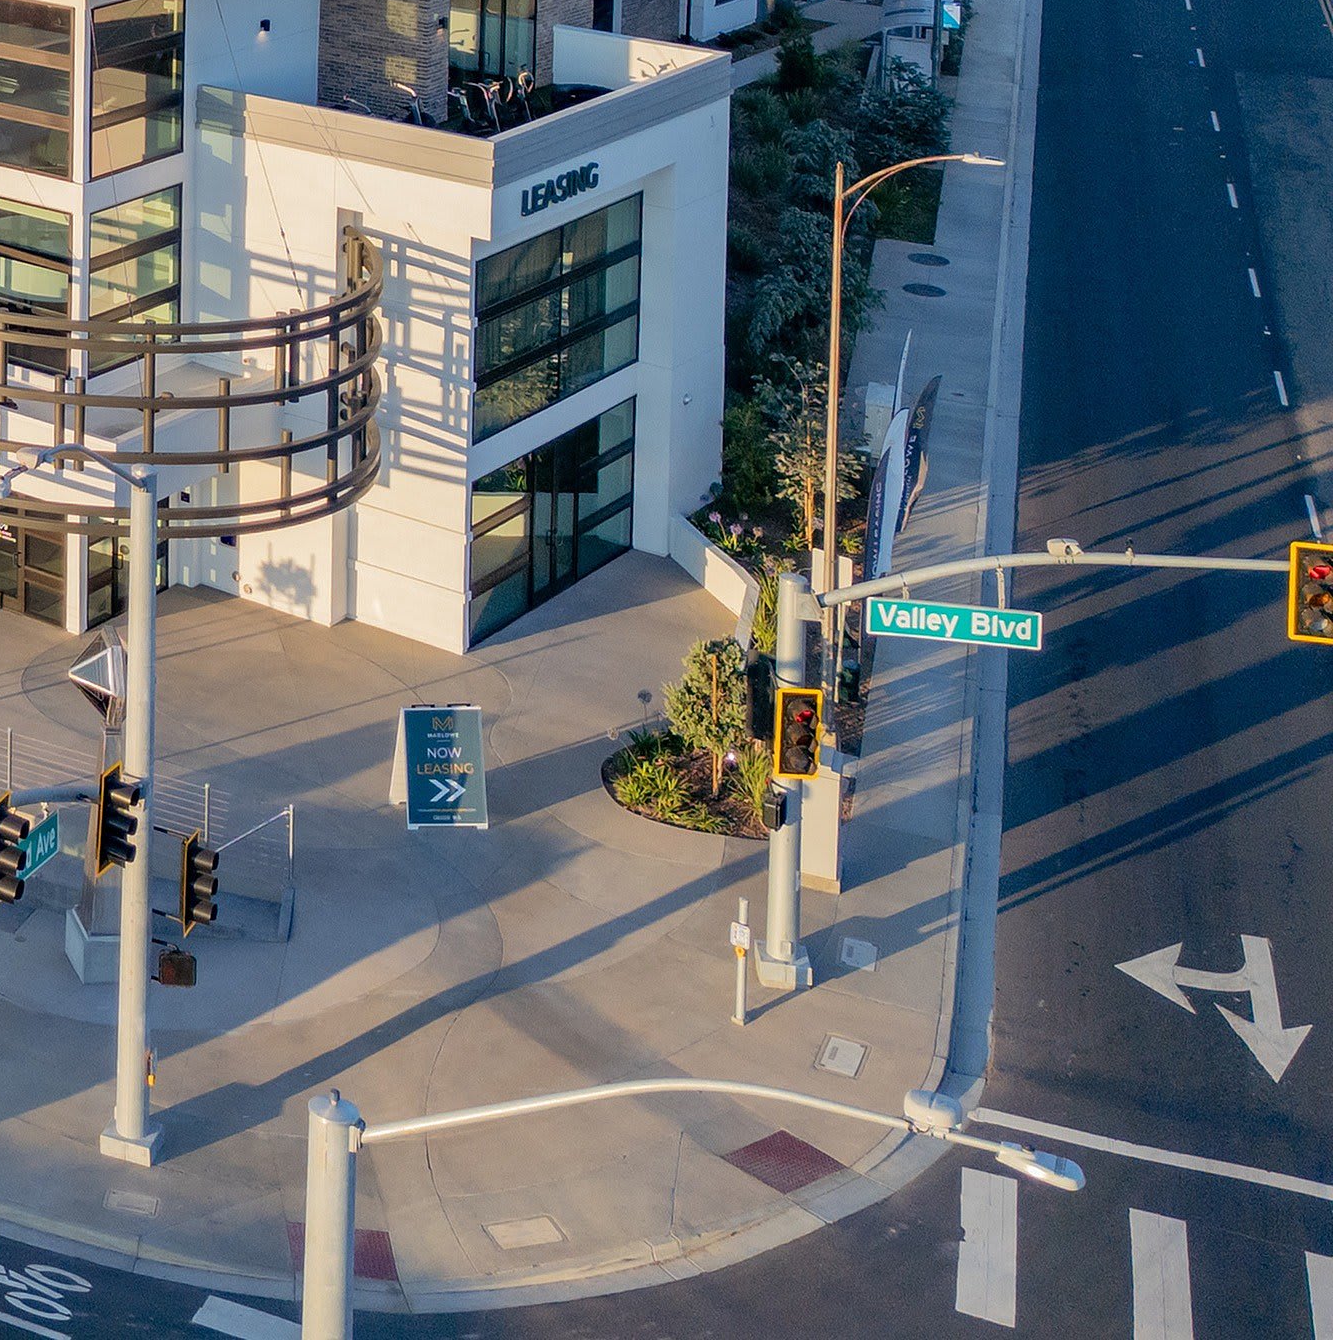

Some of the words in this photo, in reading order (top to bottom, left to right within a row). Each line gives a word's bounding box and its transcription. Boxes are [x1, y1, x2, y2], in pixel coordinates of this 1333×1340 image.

[520, 162, 599, 217] LEASING
[877, 603, 959, 638] Valley
[971, 612, 1032, 640] Blvd
[416, 763, 474, 774] LEASING
[427, 747, 462, 758] NOW
[36, 828, 55, 862] Ave
